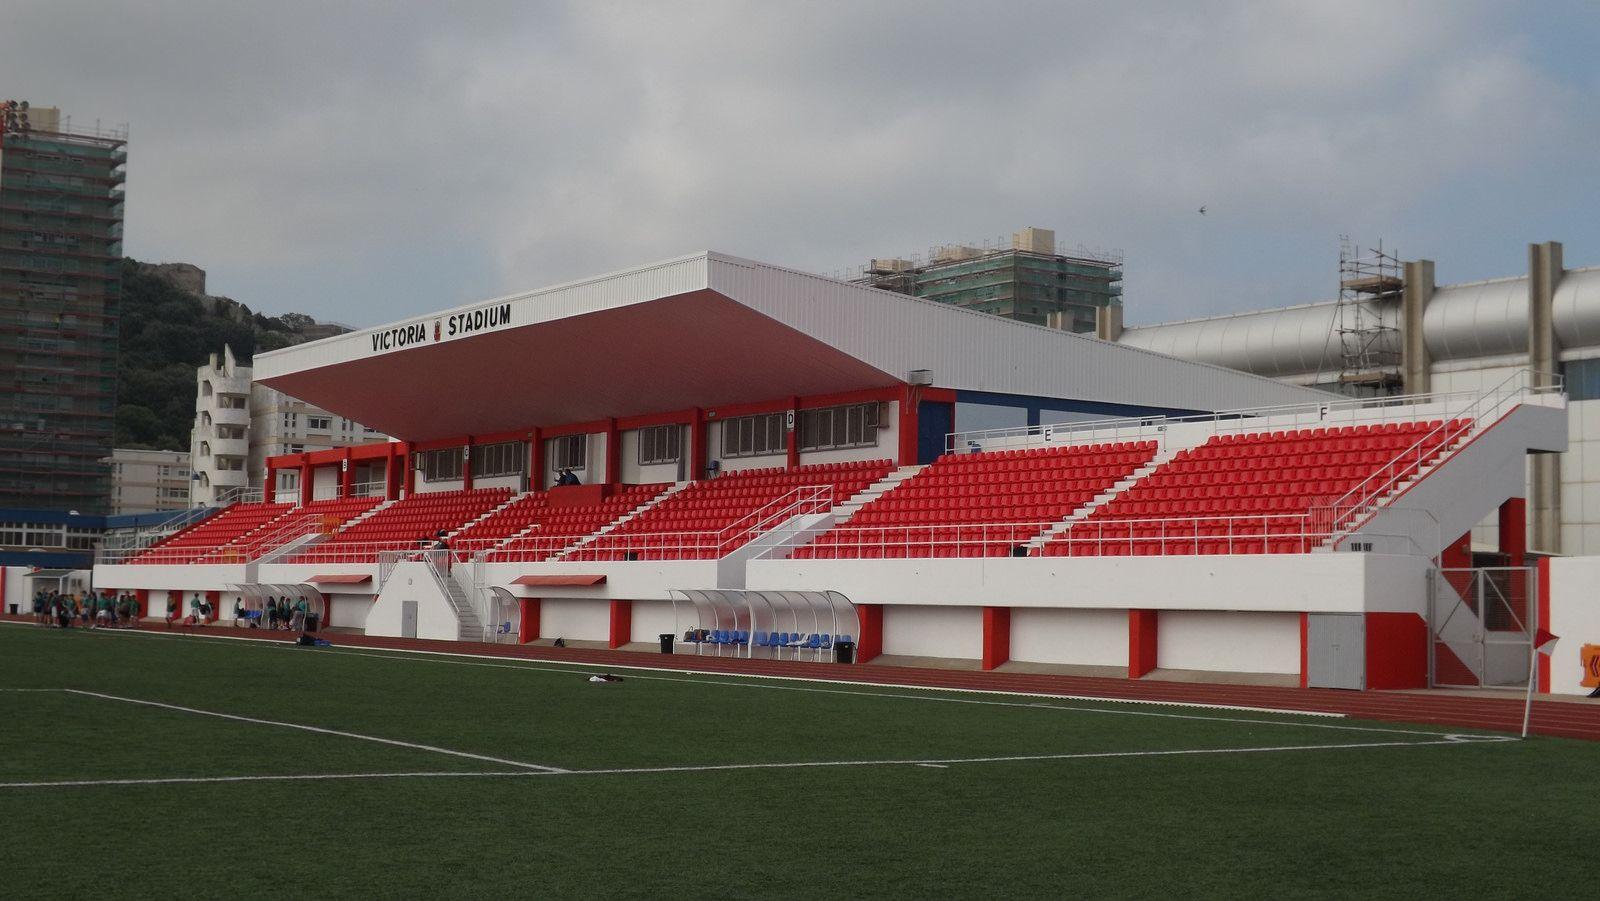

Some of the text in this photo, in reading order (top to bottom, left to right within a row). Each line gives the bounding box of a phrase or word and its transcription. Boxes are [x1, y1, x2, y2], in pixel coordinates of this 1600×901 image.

[372, 304, 511, 352] VICTORIA STADIUM
[788, 413, 794, 425] D
[1320, 406, 1328, 421] F
[1045, 429, 1052, 441] E
